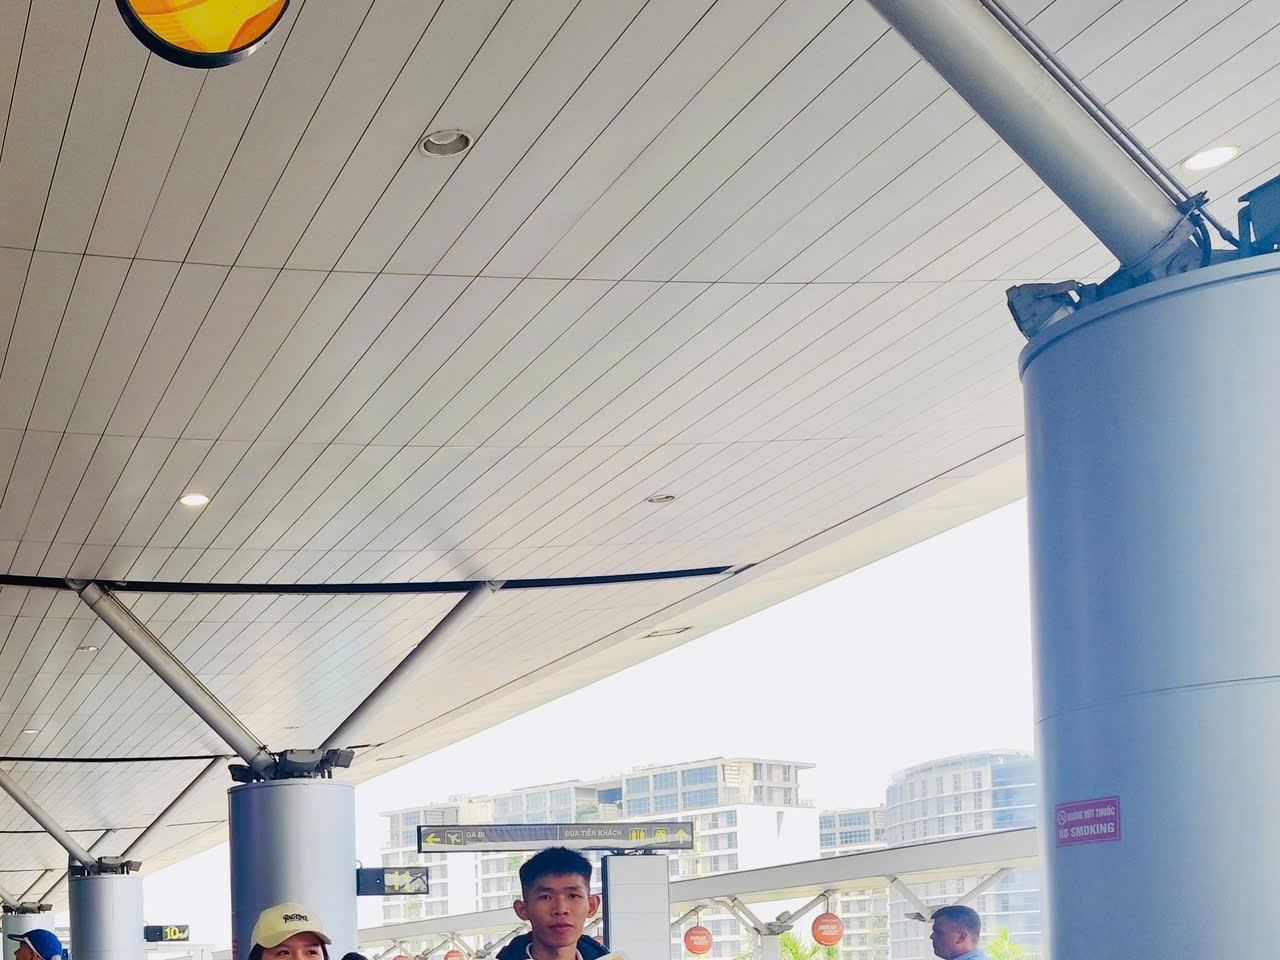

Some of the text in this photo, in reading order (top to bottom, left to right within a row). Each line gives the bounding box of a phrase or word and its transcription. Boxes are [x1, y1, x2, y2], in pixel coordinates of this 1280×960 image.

[1095, 804, 1115, 818] THUỐC
[1058, 822, 1115, 840] NO SMOKING
[165, 926, 178, 939] 10
